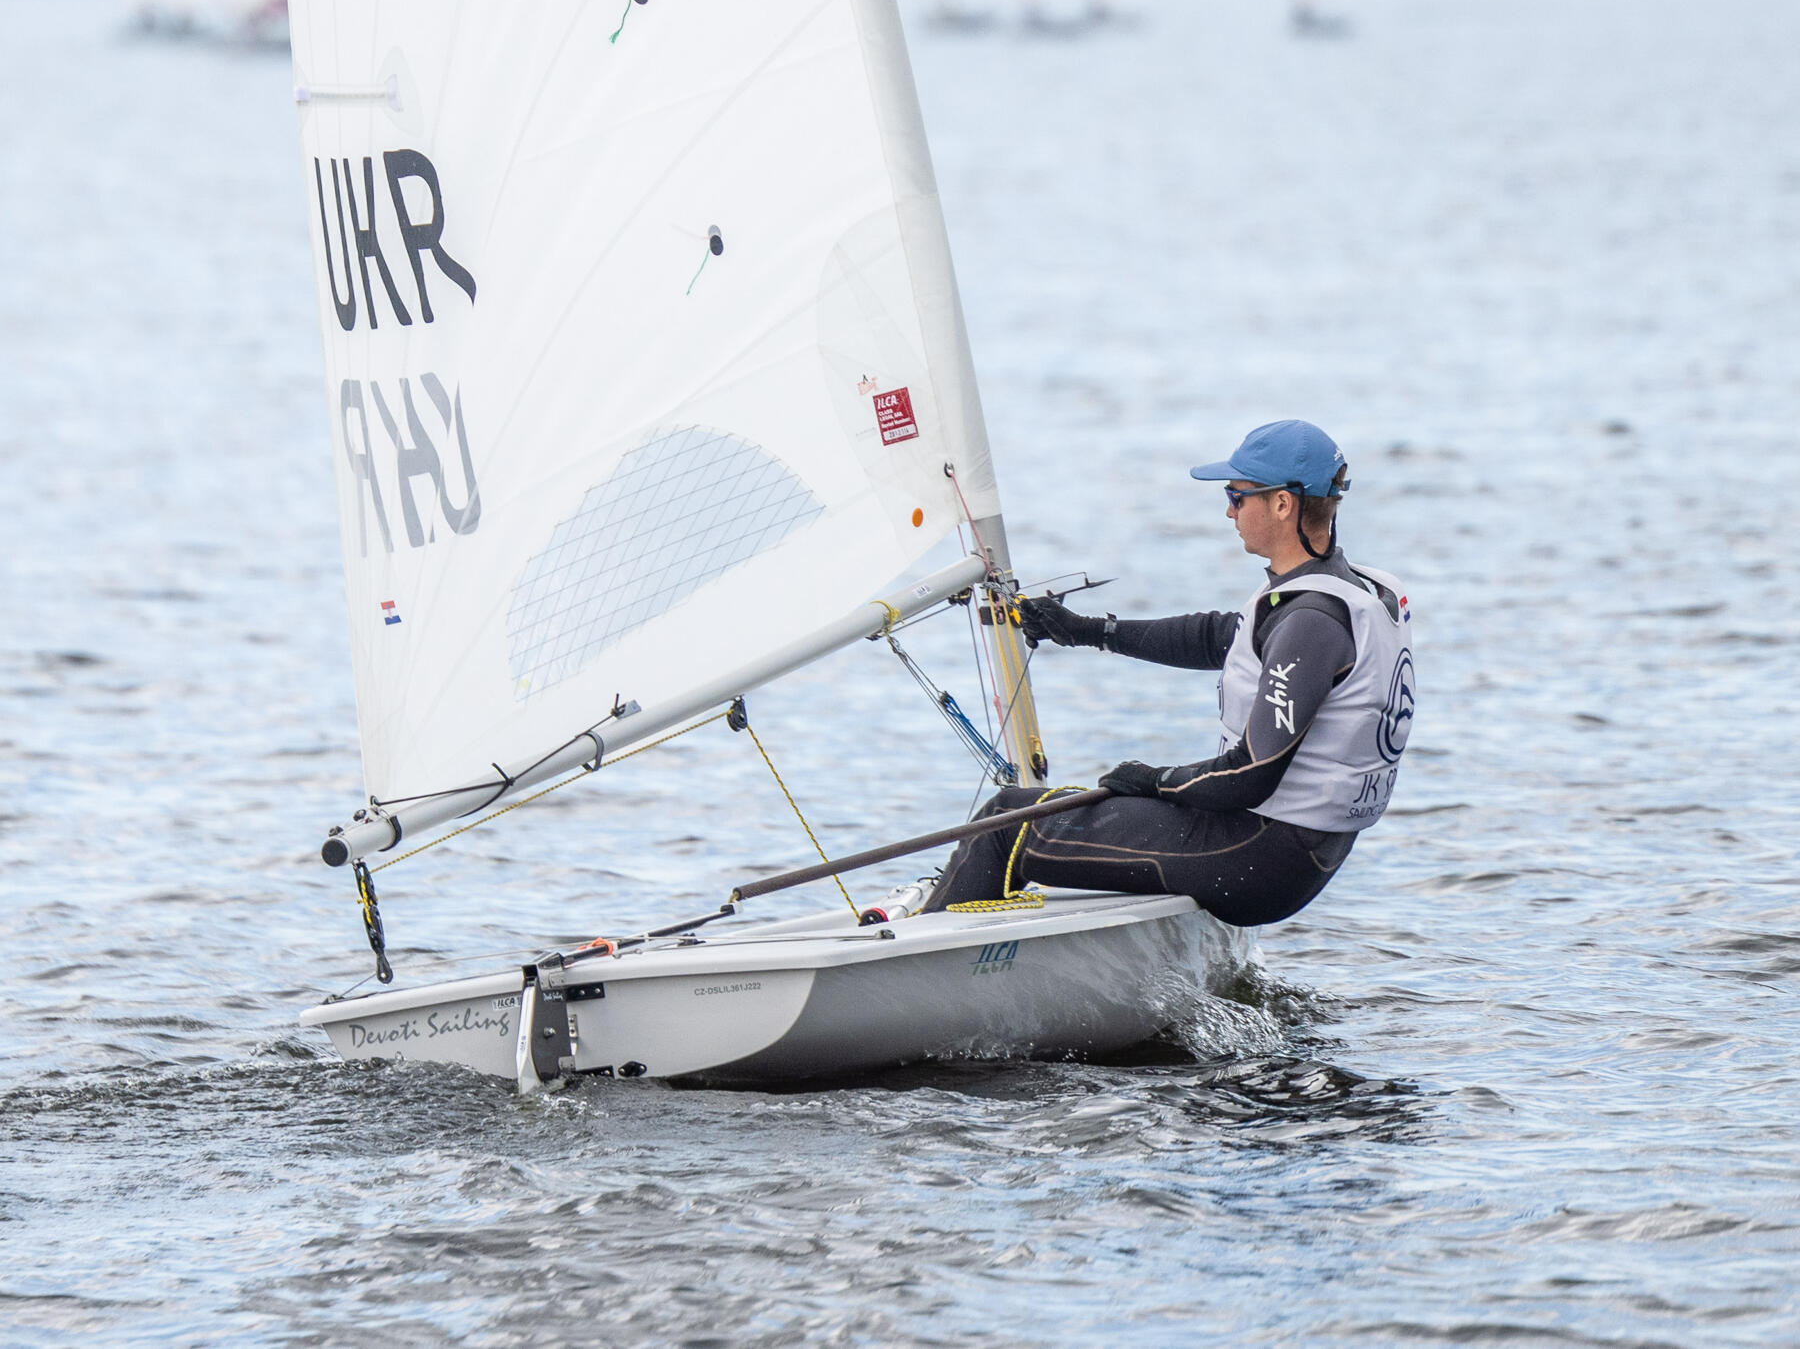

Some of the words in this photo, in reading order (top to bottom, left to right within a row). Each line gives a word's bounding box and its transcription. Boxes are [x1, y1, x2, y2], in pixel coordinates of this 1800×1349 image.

[314, 148, 477, 332] UKR
[876, 395, 898, 410] ILCA
[1353, 773, 1381, 803] JK
[968, 940, 1020, 976] ILCA
[497, 996, 516, 1008] ILCA
[348, 1020, 421, 1048] Devoti
[426, 1007, 511, 1039] Sailing
